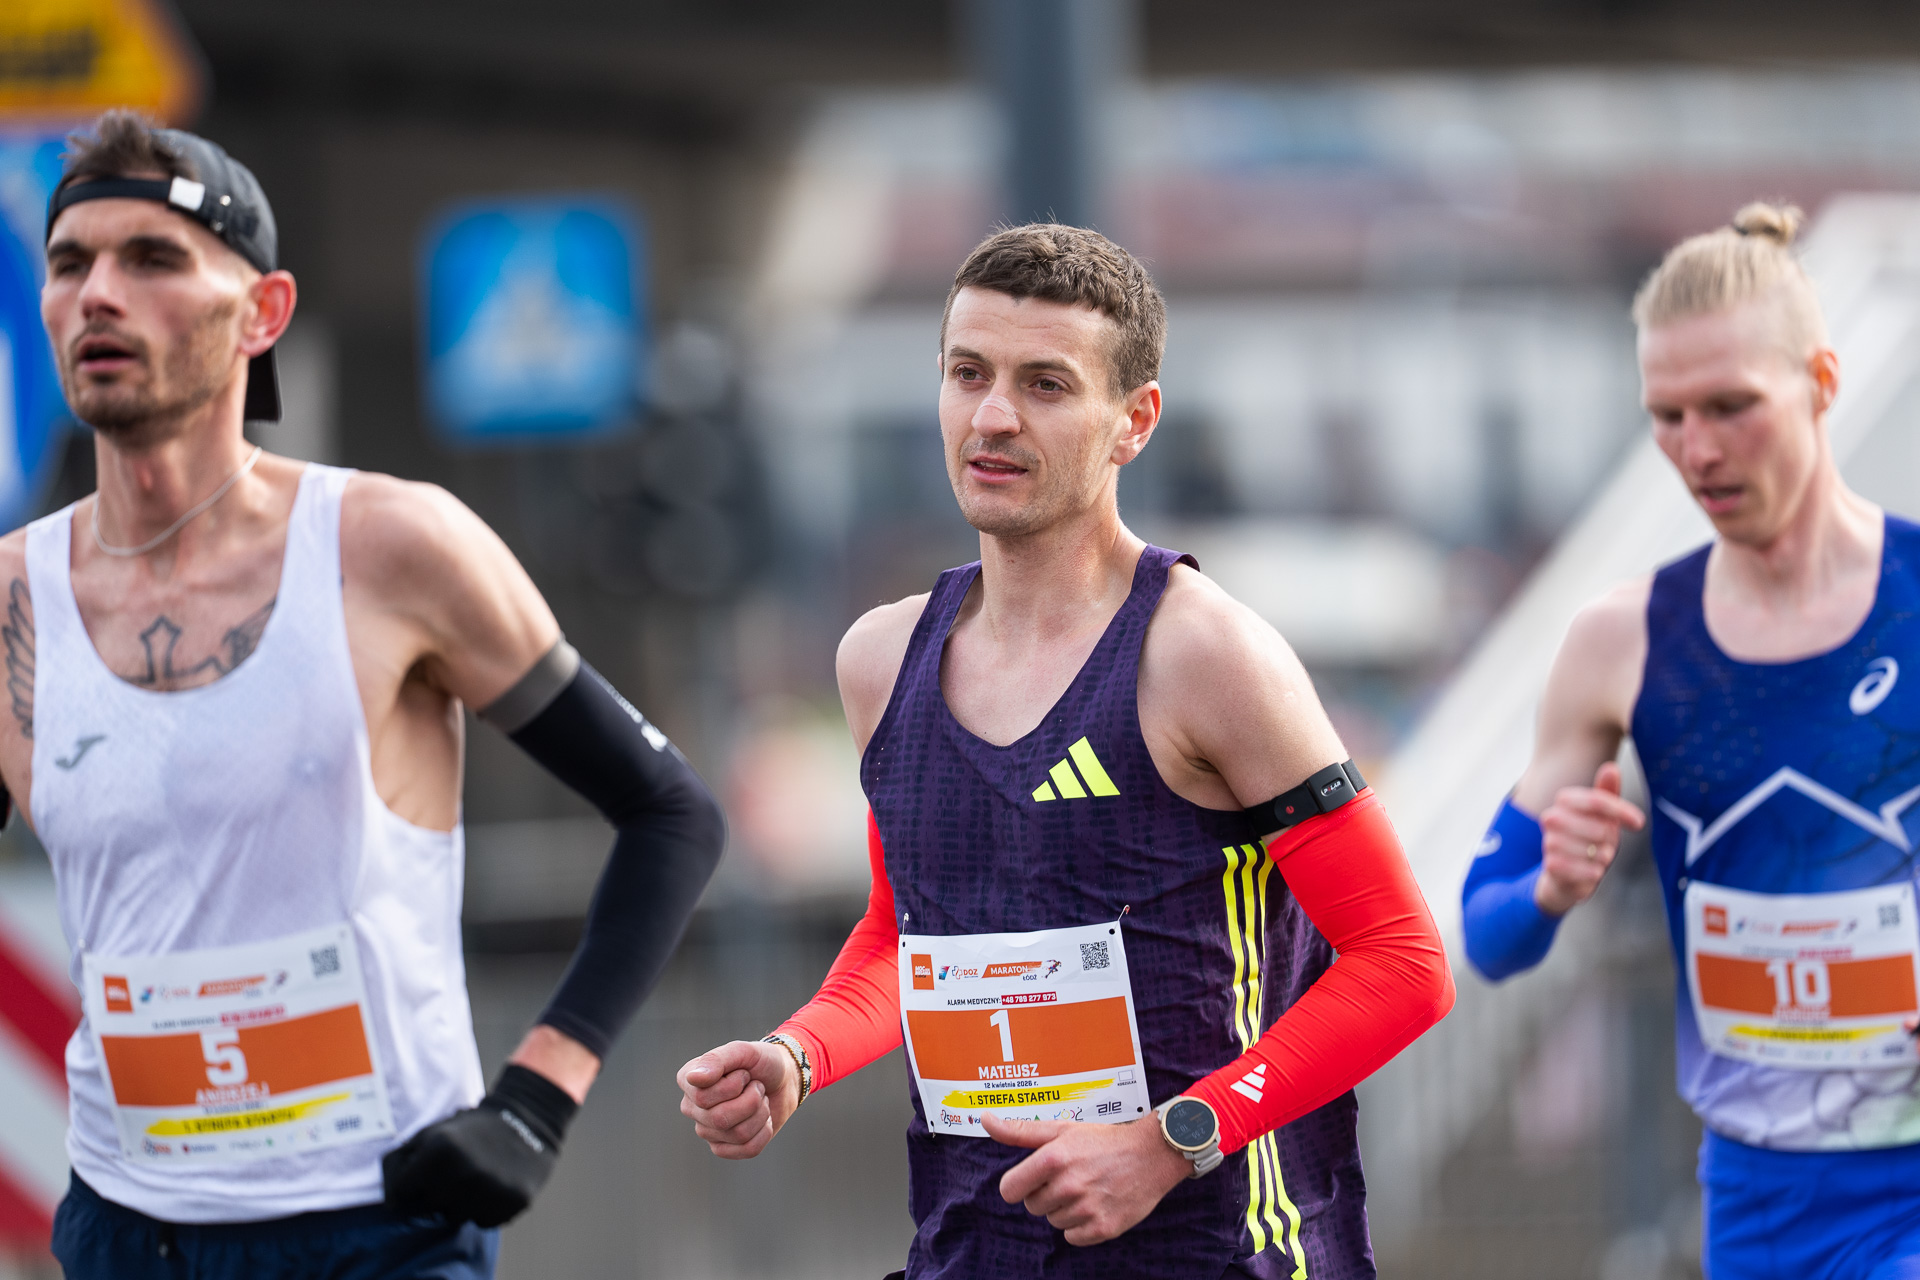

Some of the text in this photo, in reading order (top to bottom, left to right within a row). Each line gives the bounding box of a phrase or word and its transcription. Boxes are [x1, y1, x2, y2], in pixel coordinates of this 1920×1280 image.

[963, 968, 978, 976] DOZ
[990, 965, 1028, 975] MARATON
[1765, 958, 1831, 1006] 10
[967, 997, 1001, 1005] MEDYCZNY:
[1028, 994, 1042, 1002] 277
[990, 1009, 1014, 1063] 1
[200, 1027, 249, 1086] 5
[978, 1063, 1039, 1080] MATEUSZ
[968, 1090, 1060, 1105] 1. STREFA STARTU
[1096, 1101, 1122, 1114] ale
